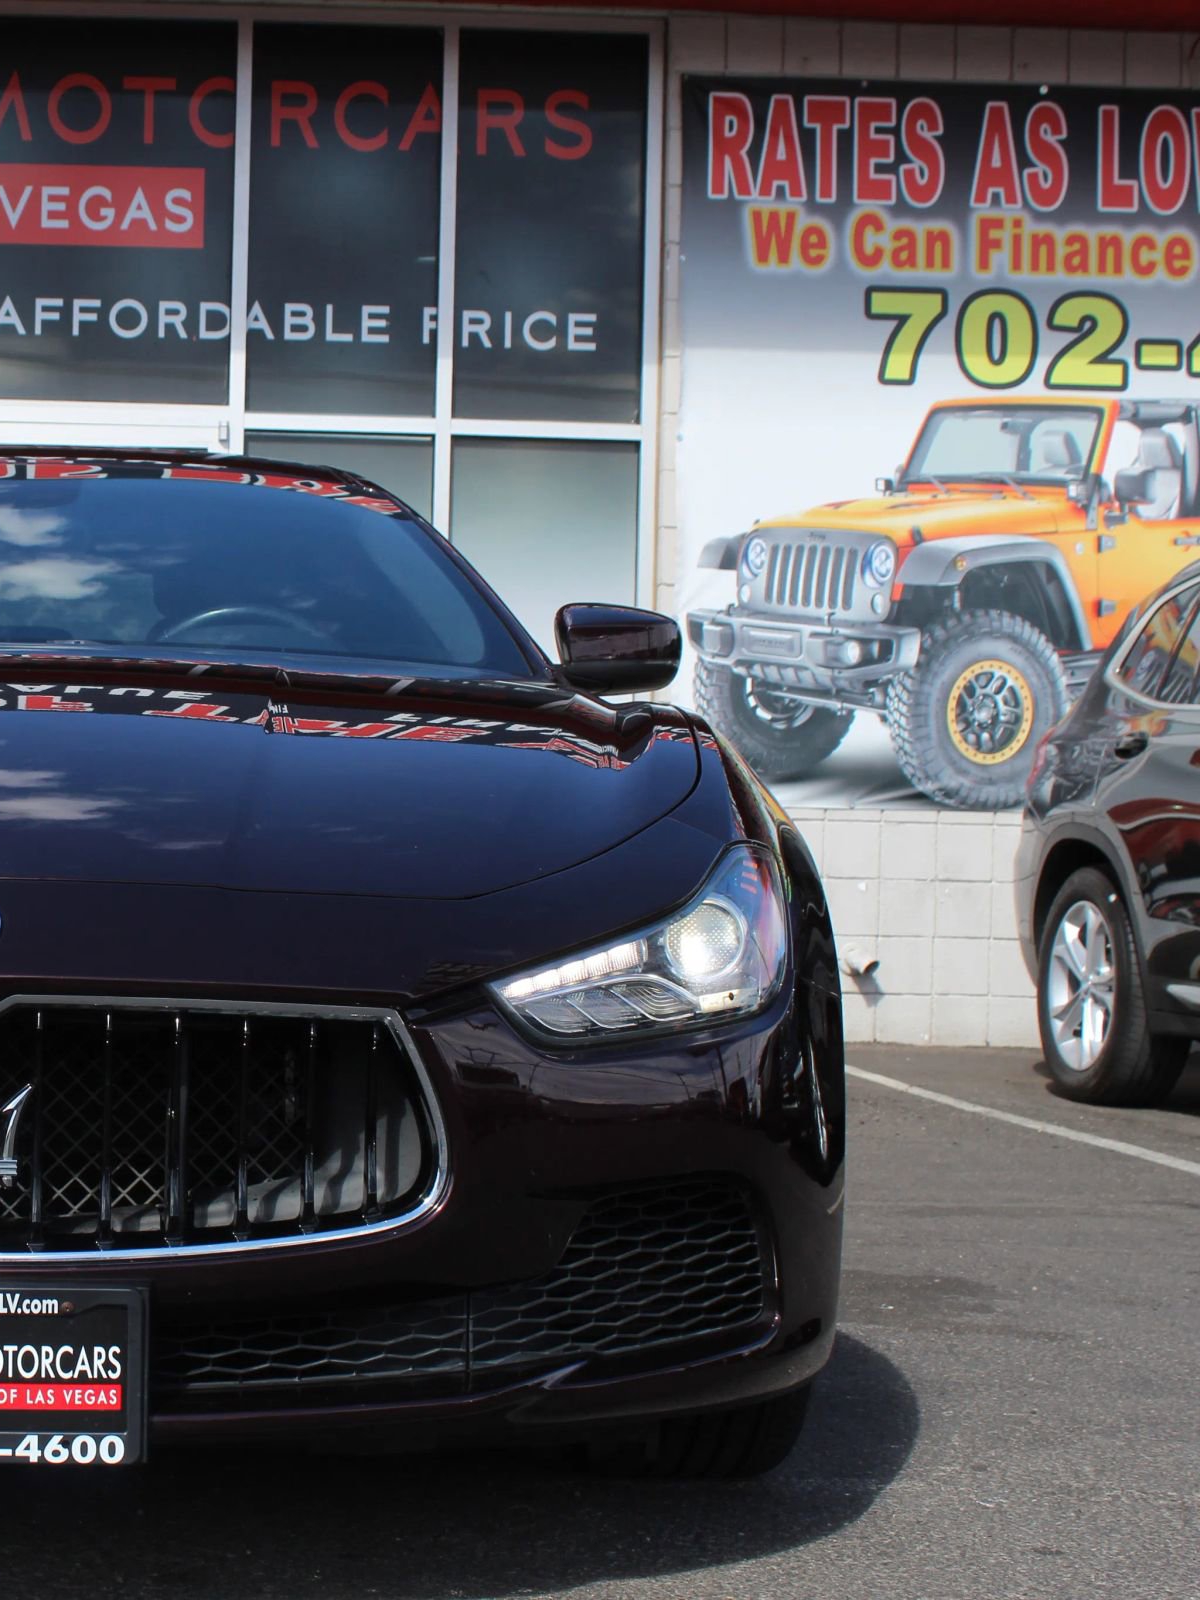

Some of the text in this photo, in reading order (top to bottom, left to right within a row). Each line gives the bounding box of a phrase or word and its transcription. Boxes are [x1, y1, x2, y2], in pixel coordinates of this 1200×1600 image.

[708, 93, 1200, 216] RATES AS LO
[749, 207, 1192, 278] We Can Finance
[865, 286, 1200, 391] 702-
[26, 1388, 55, 1405] LAS
[64, 1388, 118, 1406] VEGAS
